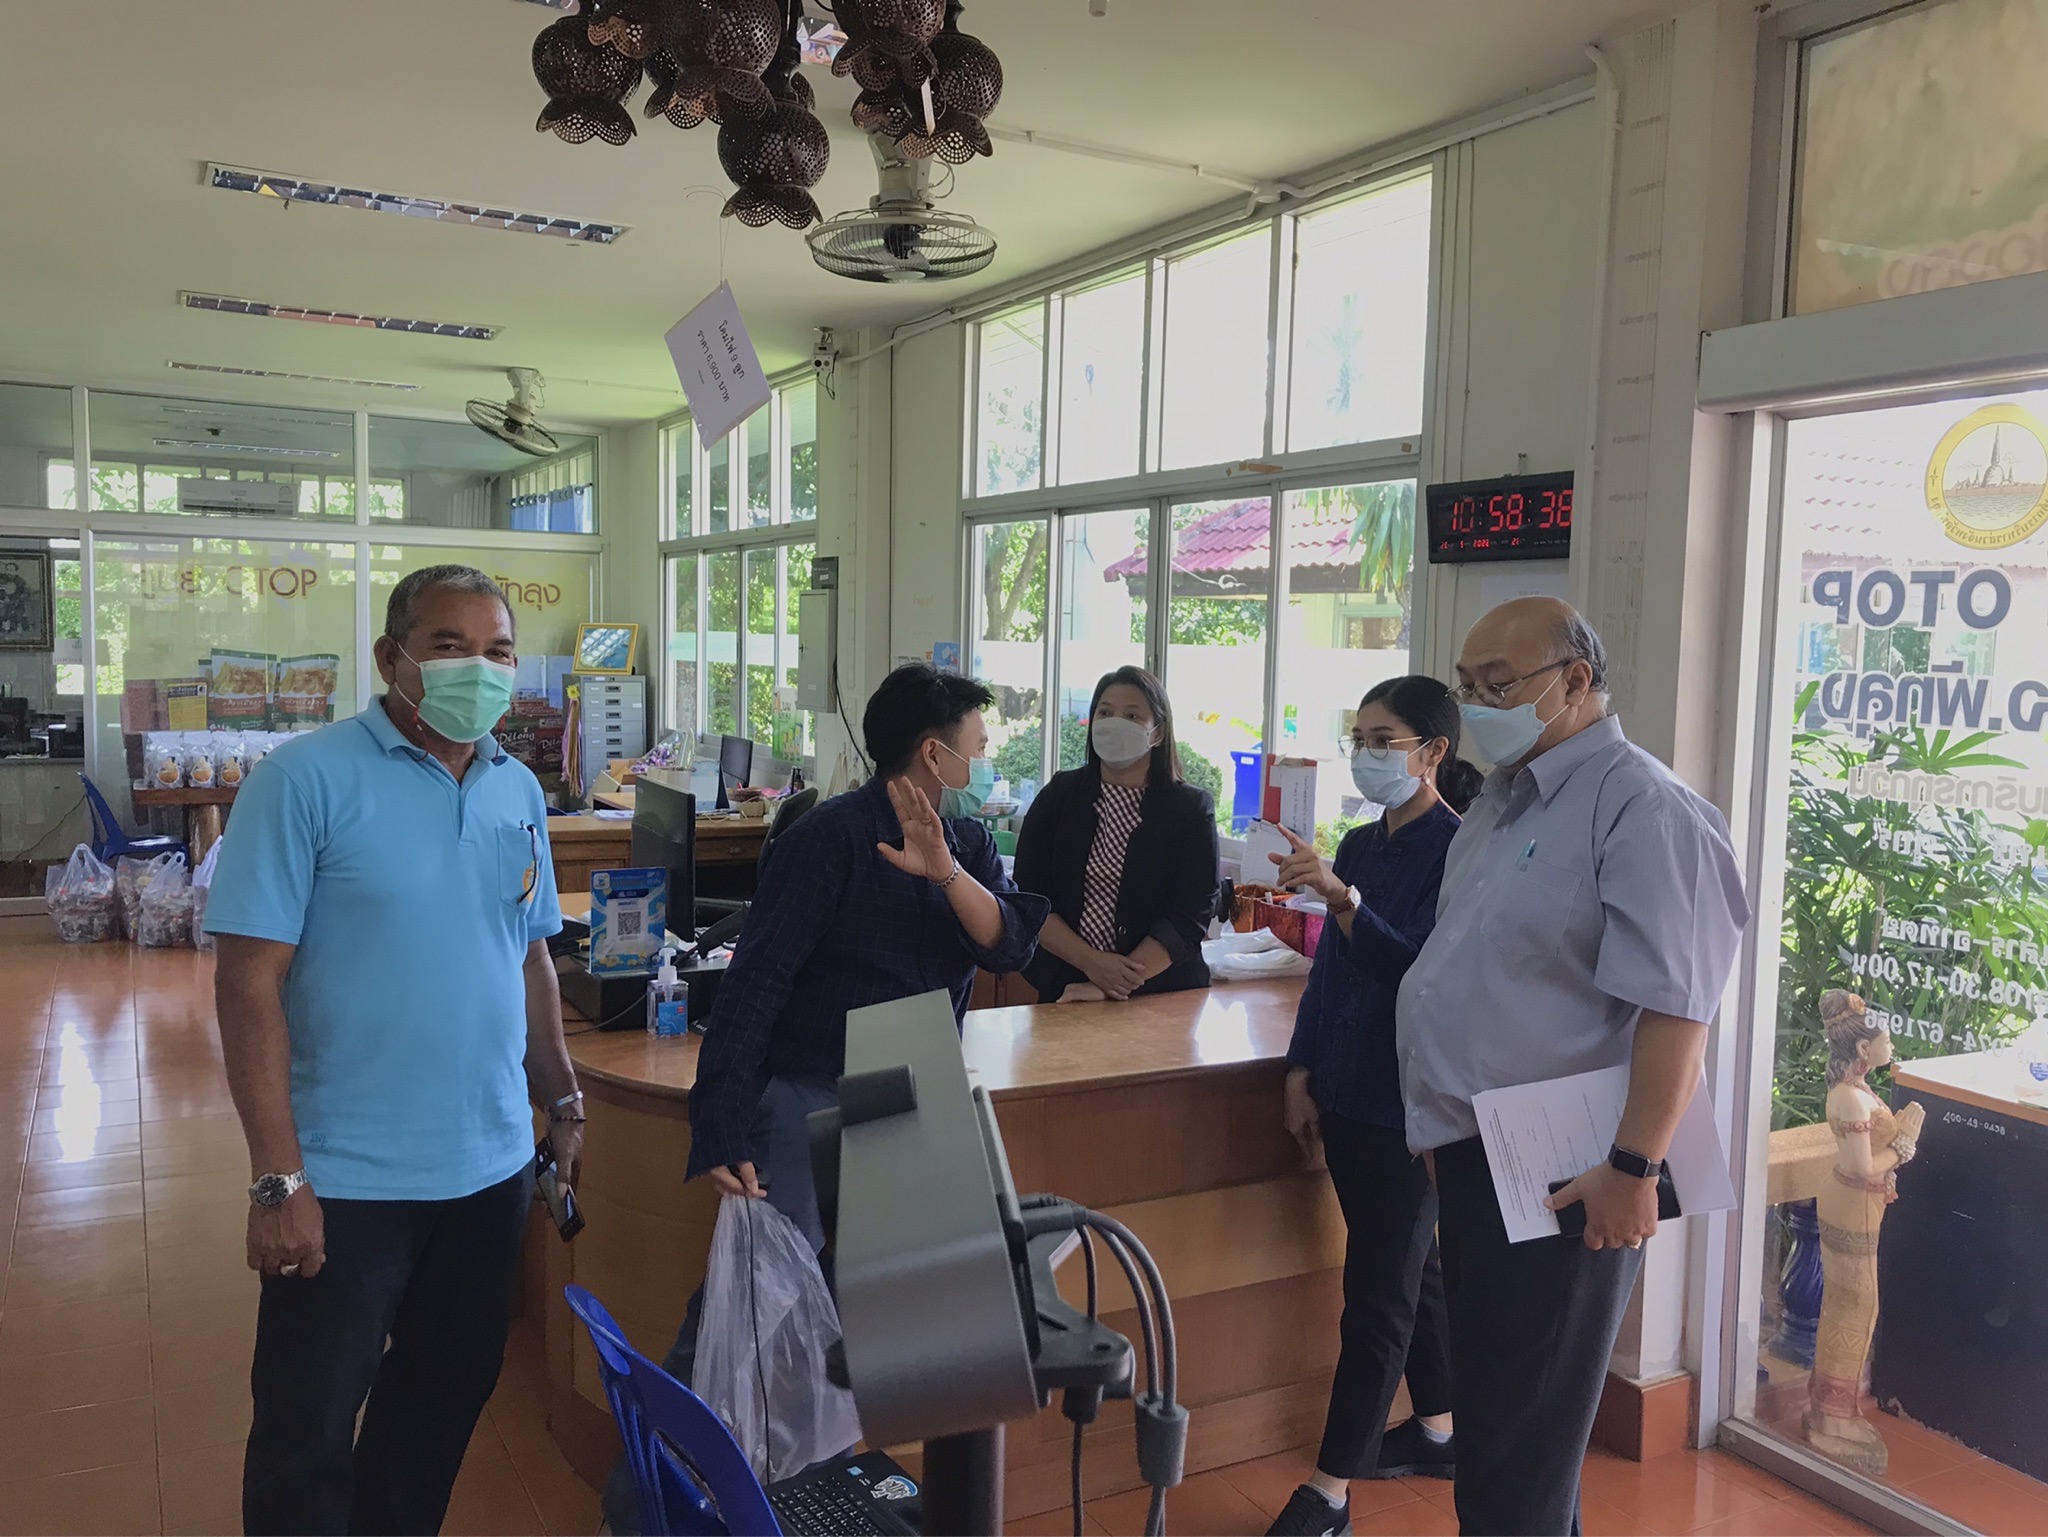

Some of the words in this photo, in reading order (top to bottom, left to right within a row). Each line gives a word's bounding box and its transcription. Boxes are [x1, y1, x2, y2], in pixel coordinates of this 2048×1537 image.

[719, 319, 738, 354] โคมไฟ
[697, 329, 709, 354] ราคา
[706, 353, 722, 381] 6,900
[718, 380, 730, 403] บาท
[730, 353, 739, 363] 9
[732, 362, 745, 379] ลูก
[226, 565, 318, 598] OTOP
